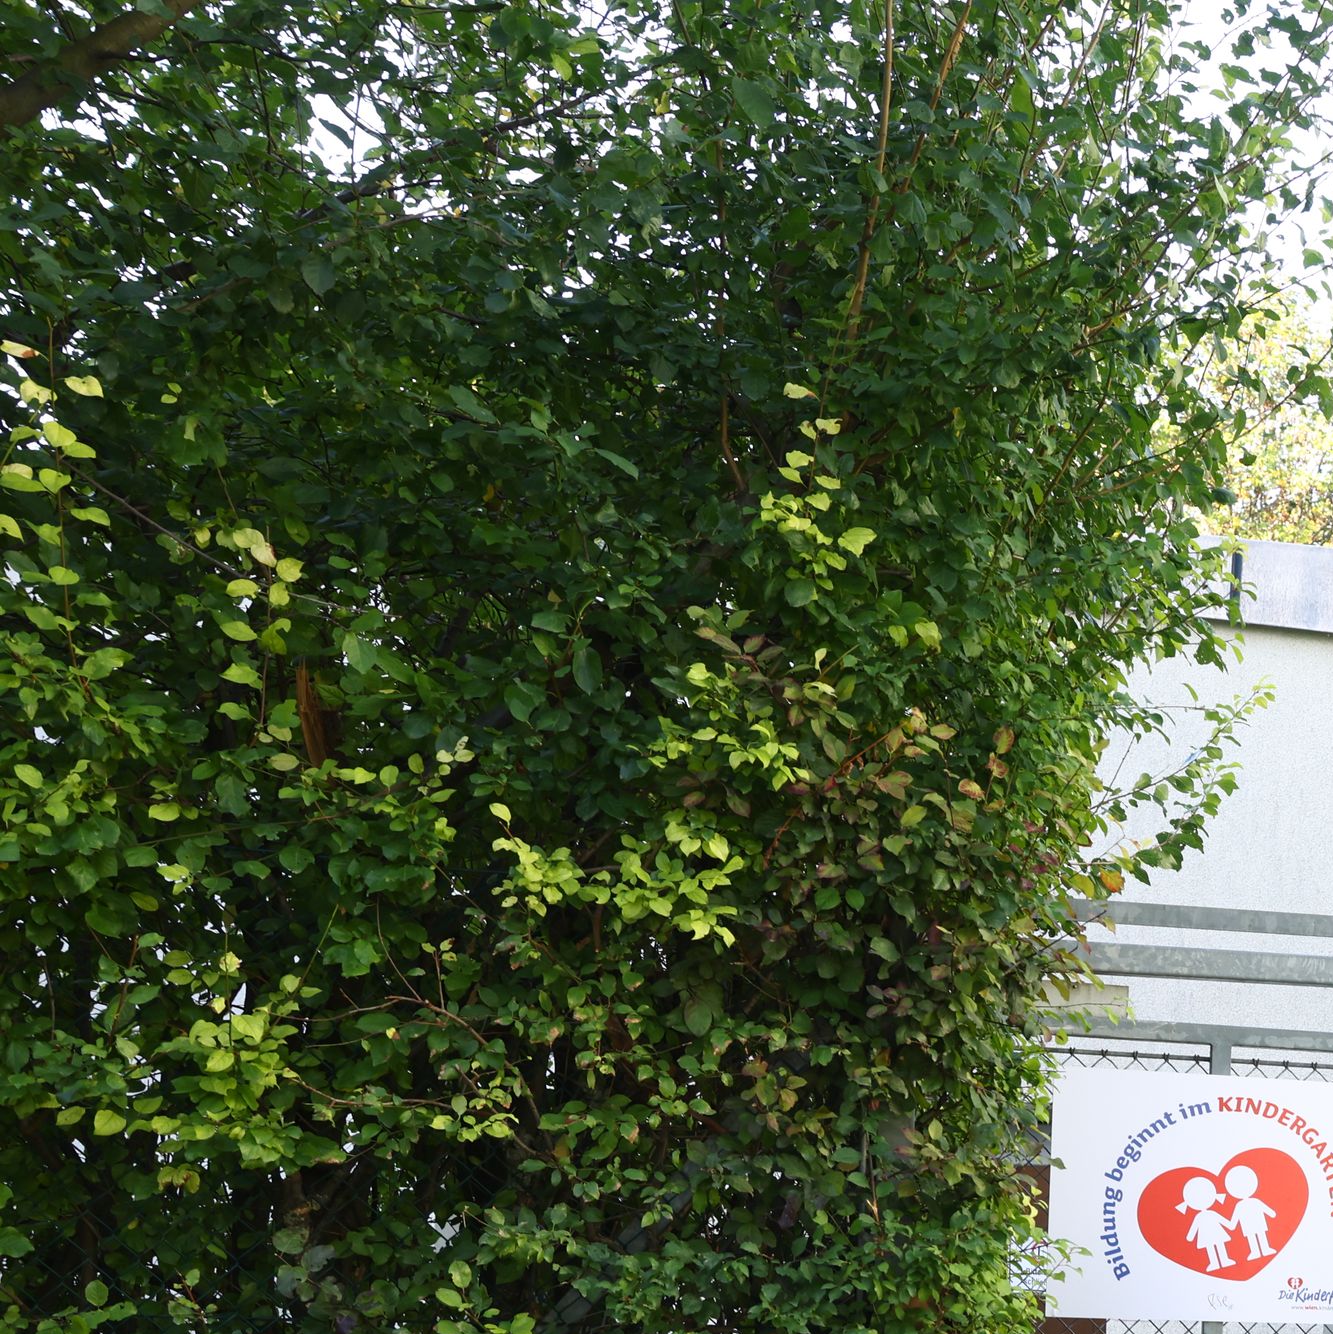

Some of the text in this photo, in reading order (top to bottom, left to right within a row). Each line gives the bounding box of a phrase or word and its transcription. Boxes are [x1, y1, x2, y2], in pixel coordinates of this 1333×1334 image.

[1178, 1101, 1212, 1119] im
[1104, 1111, 1177, 1182] beginnt
[1100, 1186, 1131, 1281] Bildung
[1278, 1289, 1294, 1300] Die
